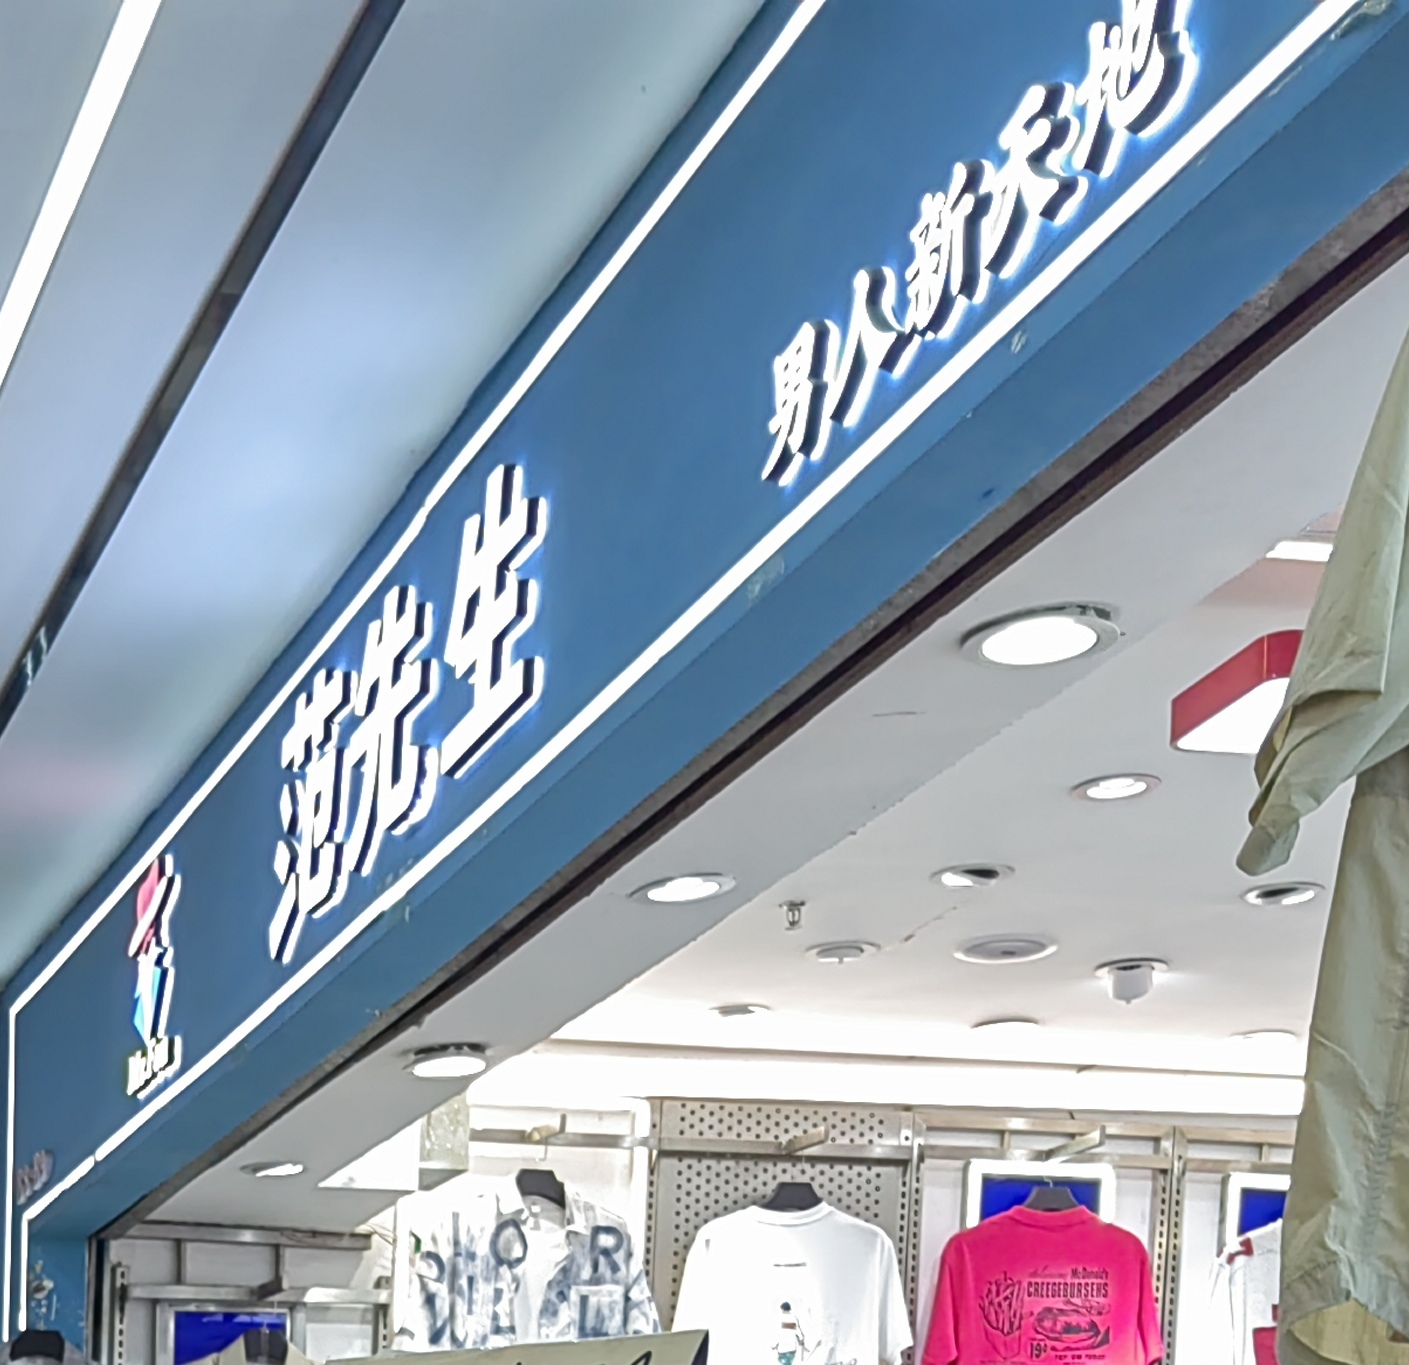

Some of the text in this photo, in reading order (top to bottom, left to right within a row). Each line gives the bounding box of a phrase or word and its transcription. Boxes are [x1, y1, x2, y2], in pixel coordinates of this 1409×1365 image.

[762, 0, 1198, 487] 男人新天地
[269, 463, 547, 965] 范先生
